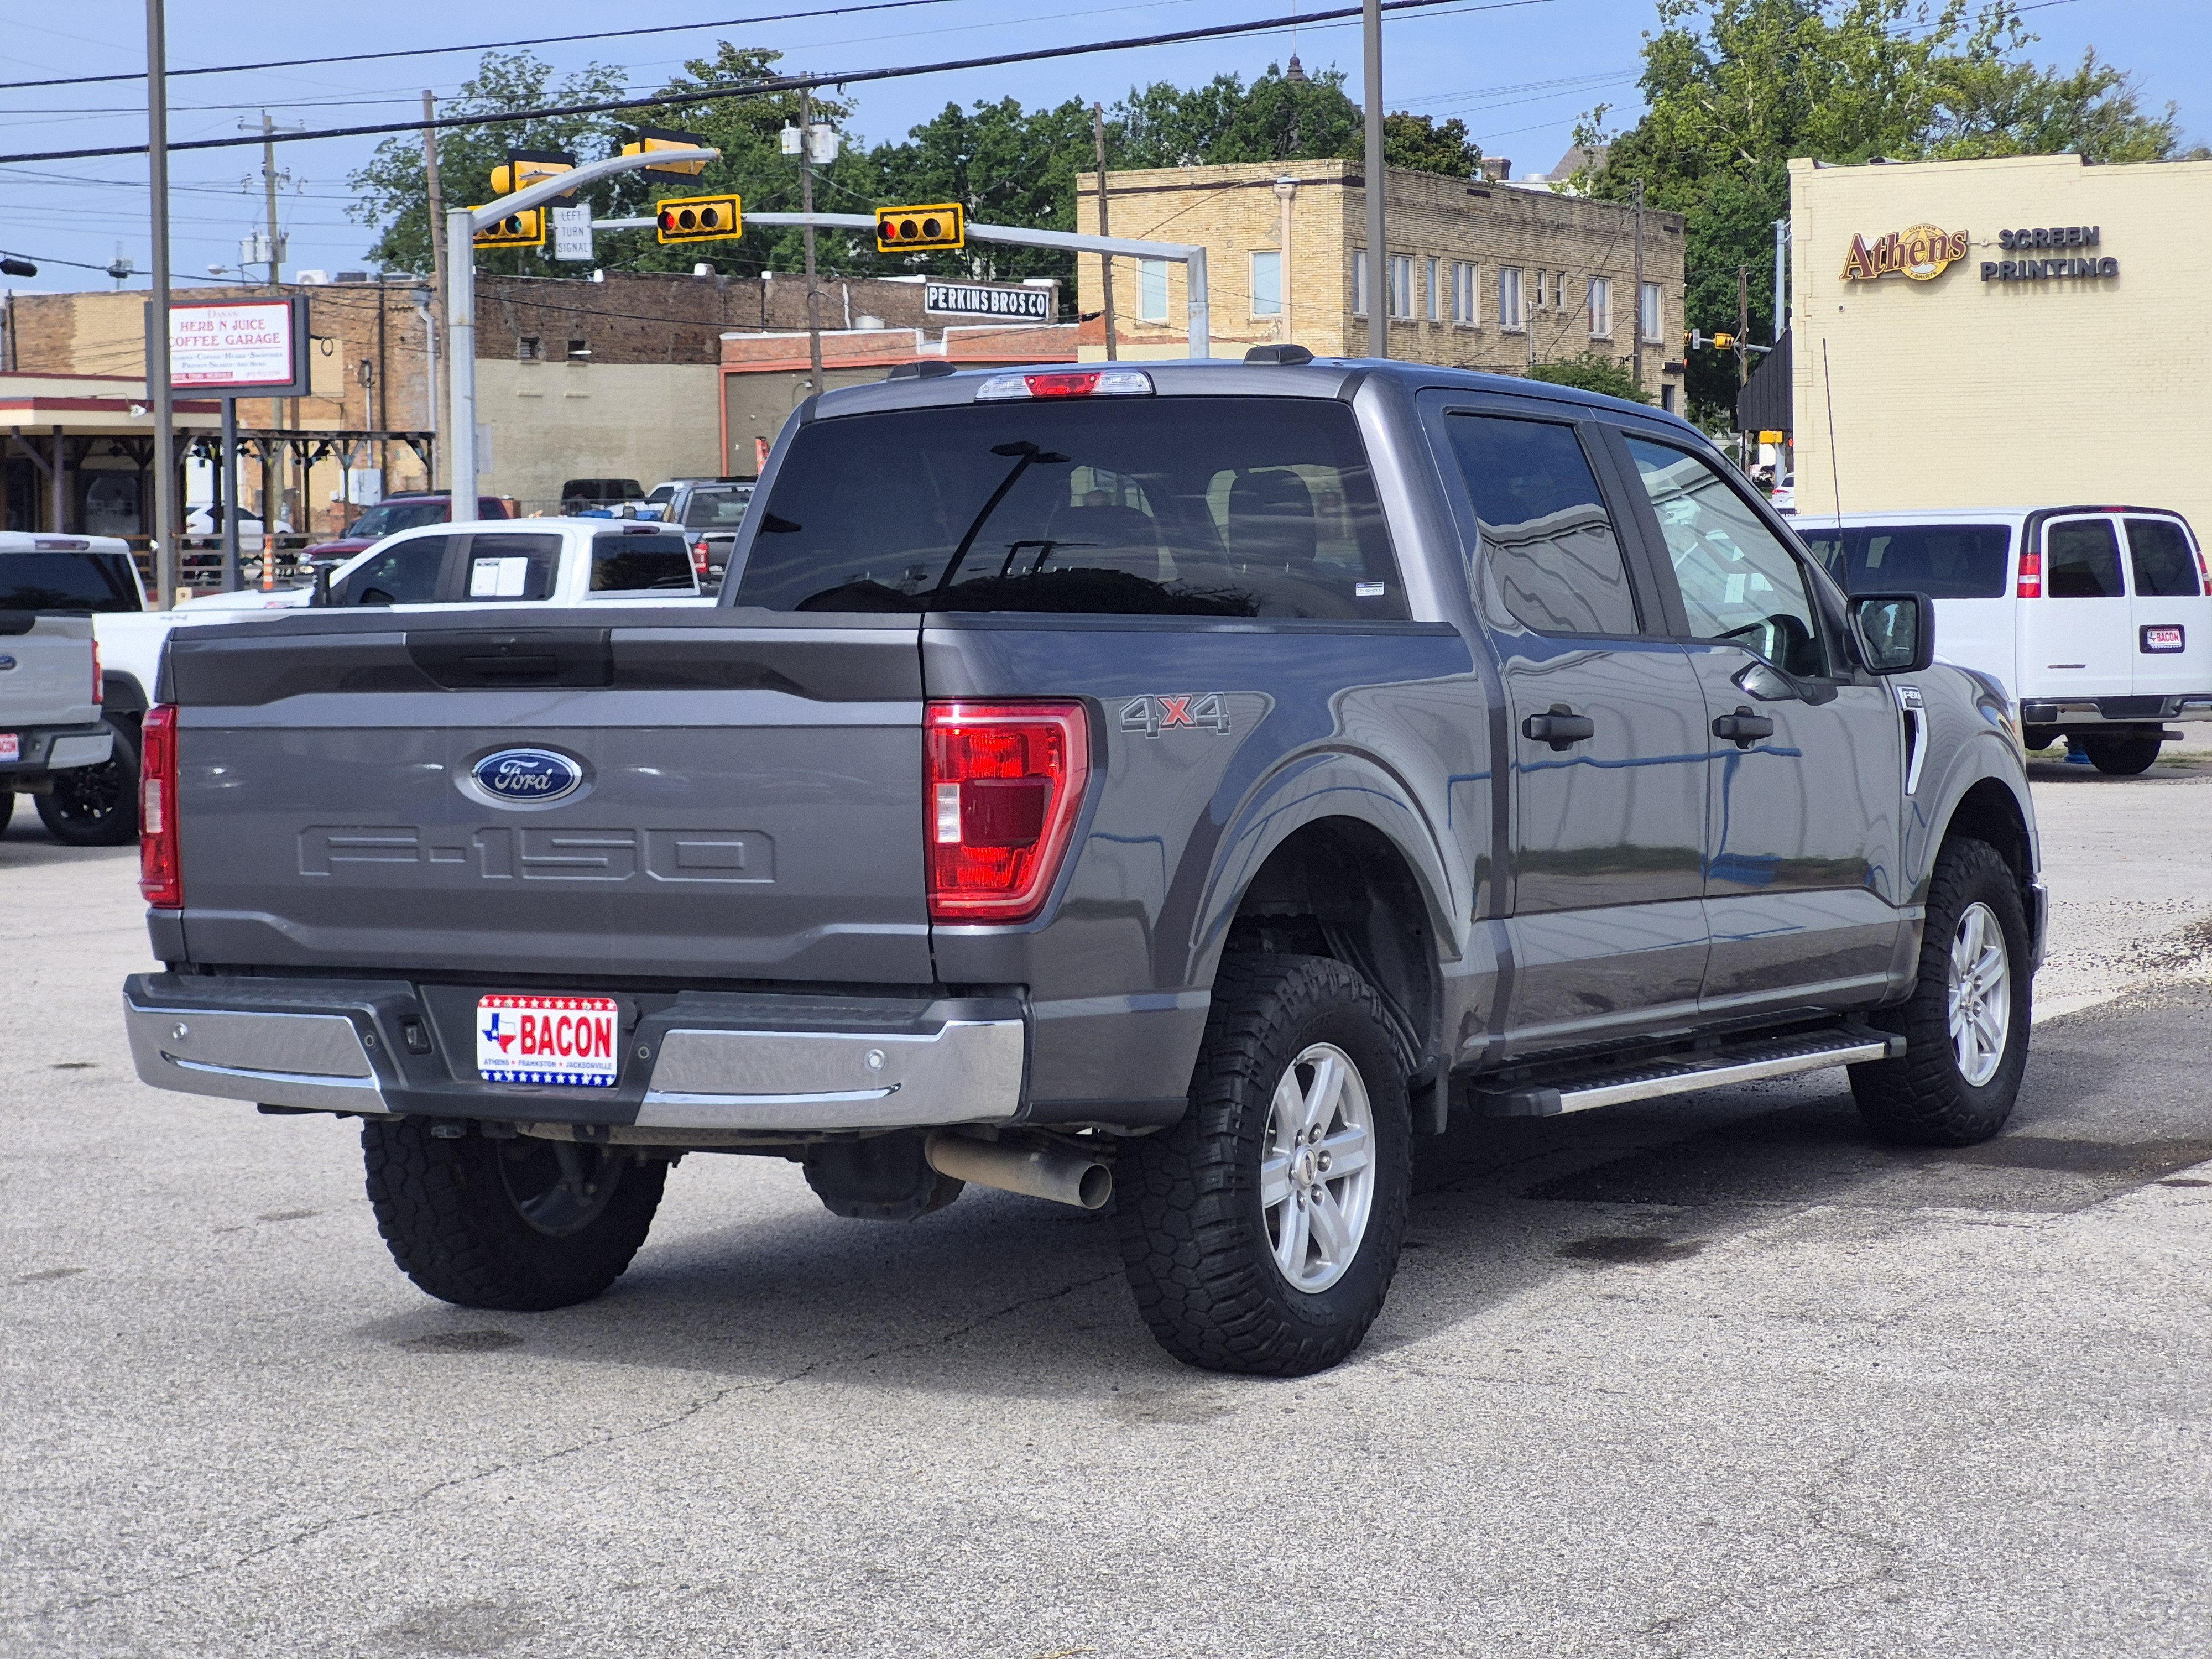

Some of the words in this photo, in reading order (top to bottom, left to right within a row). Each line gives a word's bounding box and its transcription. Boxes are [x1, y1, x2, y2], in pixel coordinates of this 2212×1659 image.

[561, 211, 581, 221] LEFT
[562, 227, 584, 237] TURN
[1999, 226, 2100, 250] SCREEN
[558, 243, 588, 253] SIGNAL
[1839, 229, 1969, 280] Athens
[1980, 257, 2119, 281] PRINTING
[929, 287, 988, 311] PERKINS
[991, 291, 1026, 314] BROS
[1029, 294, 1045, 315] CO
[180, 321, 215, 332] HERB
[219, 320, 227, 331] N
[232, 319, 266, 331] JUICE
[225, 333, 281, 345] GARAGE
[2157, 632, 2179, 641] BACON
[495, 760, 553, 790] Ford
[298, 825, 775, 883] F-150
[521, 1014, 611, 1057] BACON
[518, 1060, 556, 1068] FRANKSTON
[565, 1061, 612, 1070] JACKSONVILLE
